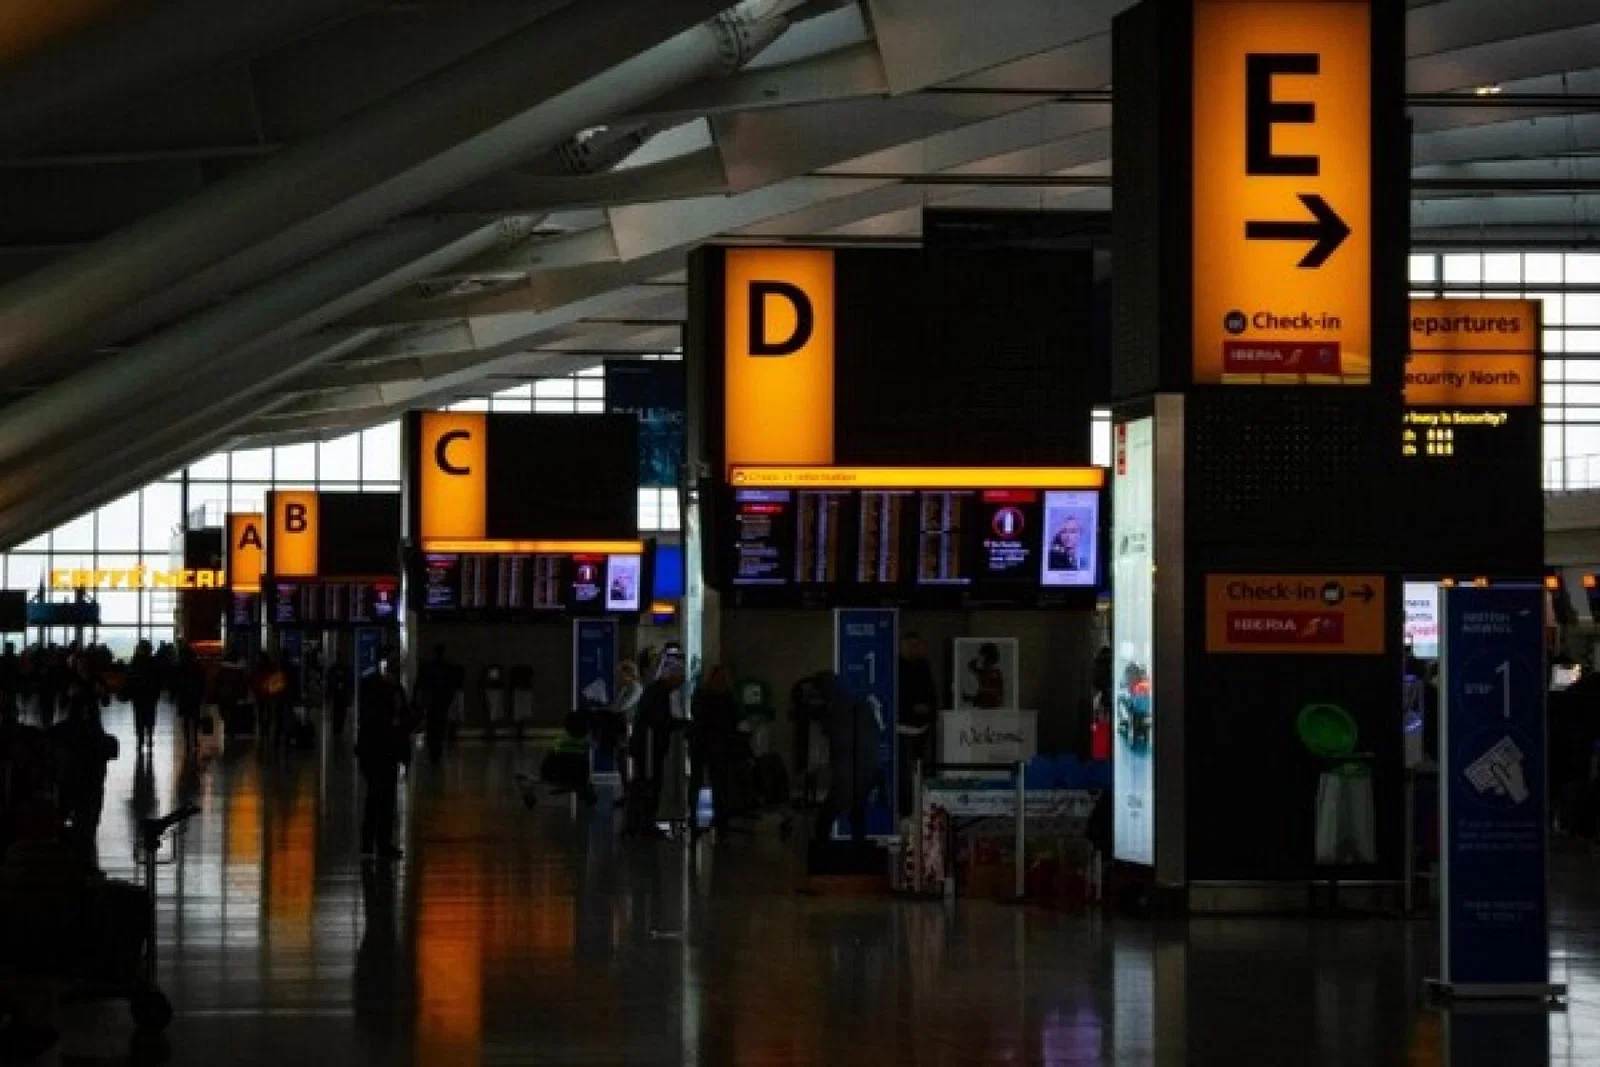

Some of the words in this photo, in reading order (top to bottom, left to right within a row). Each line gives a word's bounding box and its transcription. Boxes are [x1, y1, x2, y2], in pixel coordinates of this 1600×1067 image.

[1244, 53, 1321, 177] E
[748, 280, 814, 356] D
[1253, 311, 1341, 329] Check-in
[1411, 316, 1520, 336] epartures
[1230, 348, 1283, 361] IBERIA
[1404, 371, 1463, 388] ecurity
[1469, 371, 1520, 385] North
[434, 430, 470, 476] C
[285, 503, 308, 533] B
[238, 524, 262, 551] A
[1227, 581, 1316, 600] Check-in
[1233, 618, 1297, 631] IBERIA
